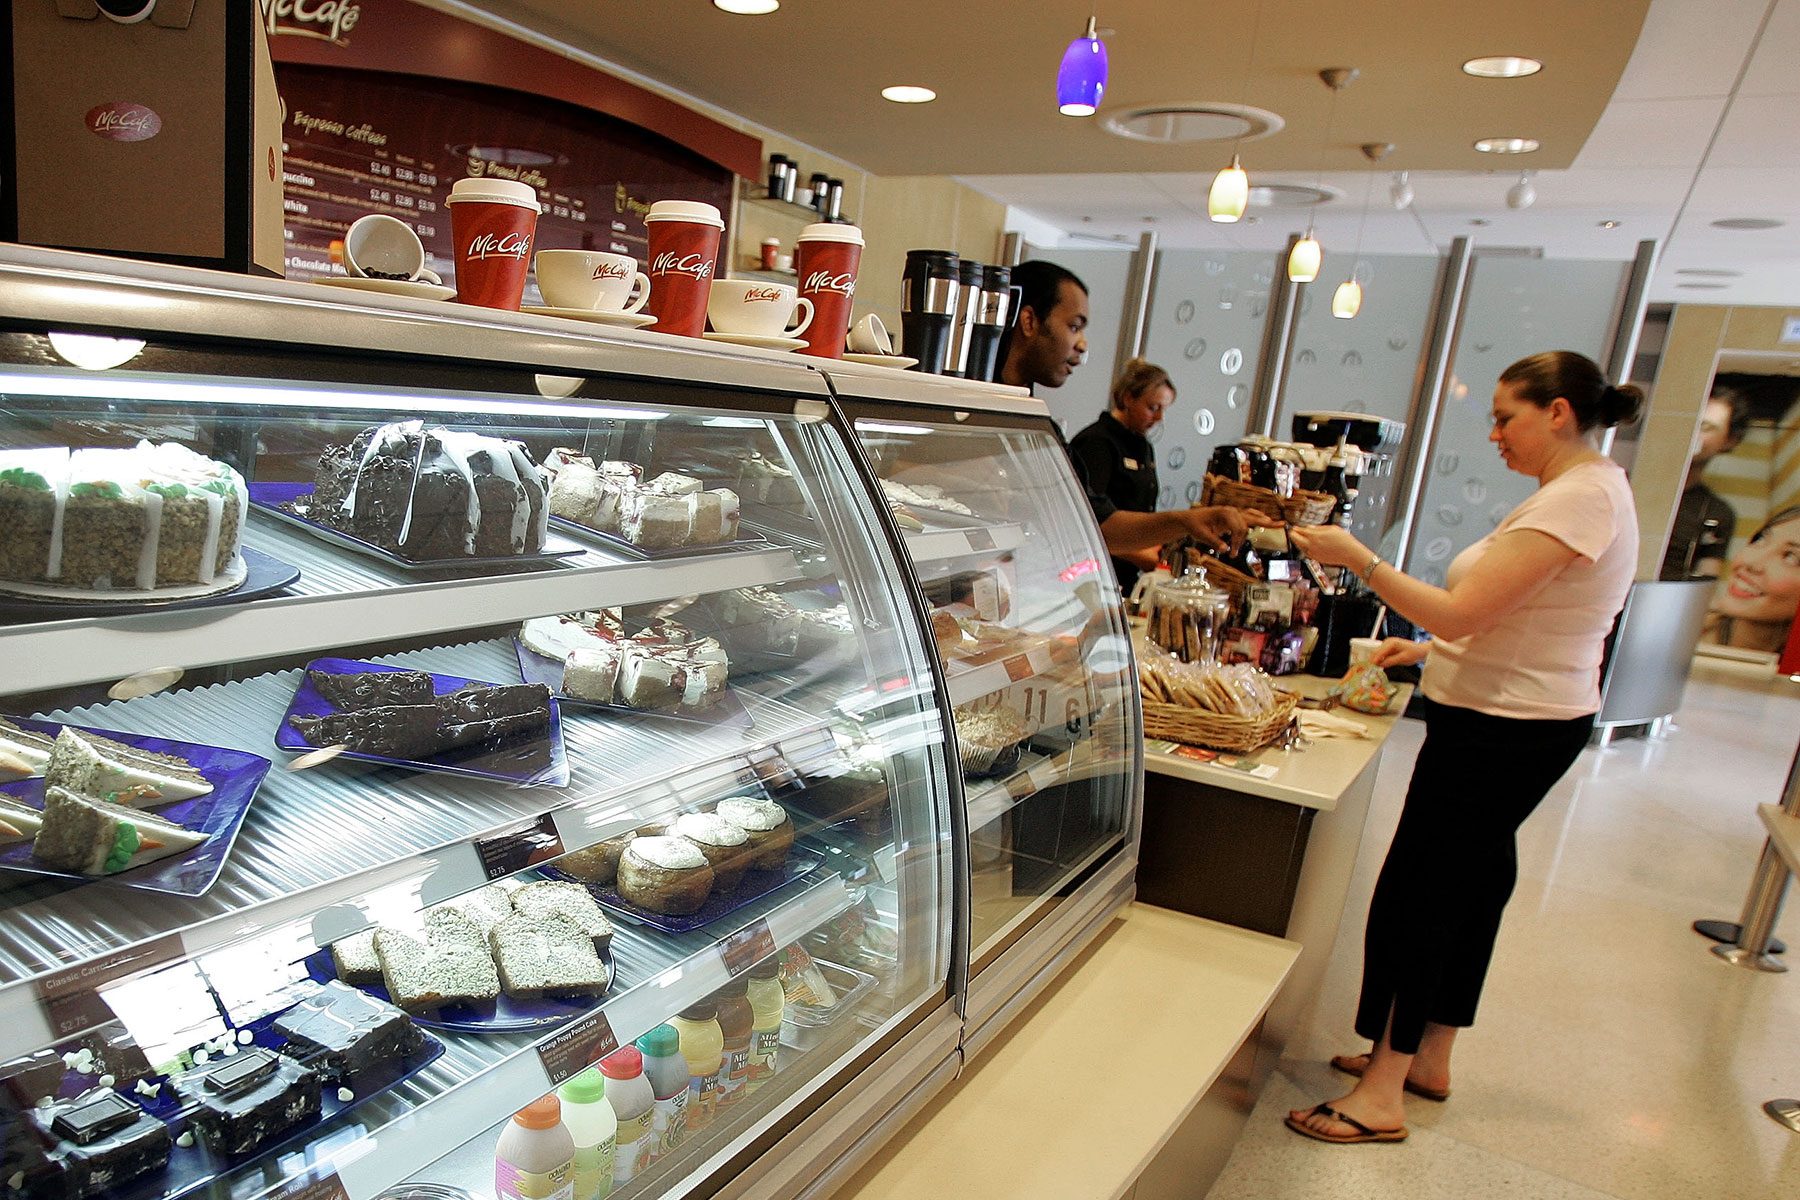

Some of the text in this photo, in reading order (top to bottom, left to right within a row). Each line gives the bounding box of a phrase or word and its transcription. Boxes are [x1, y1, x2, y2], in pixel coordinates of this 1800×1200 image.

[467, 232, 531, 261] McCafé
[651, 251, 714, 281] McCafé
[803, 270, 857, 299] McCaf
[45, 973, 80, 990] Classic
[60, 1015, 88, 1033] $2.75
[552, 1069, 568, 1082] $1.50
[288, 1181, 304, 1194] Roll
